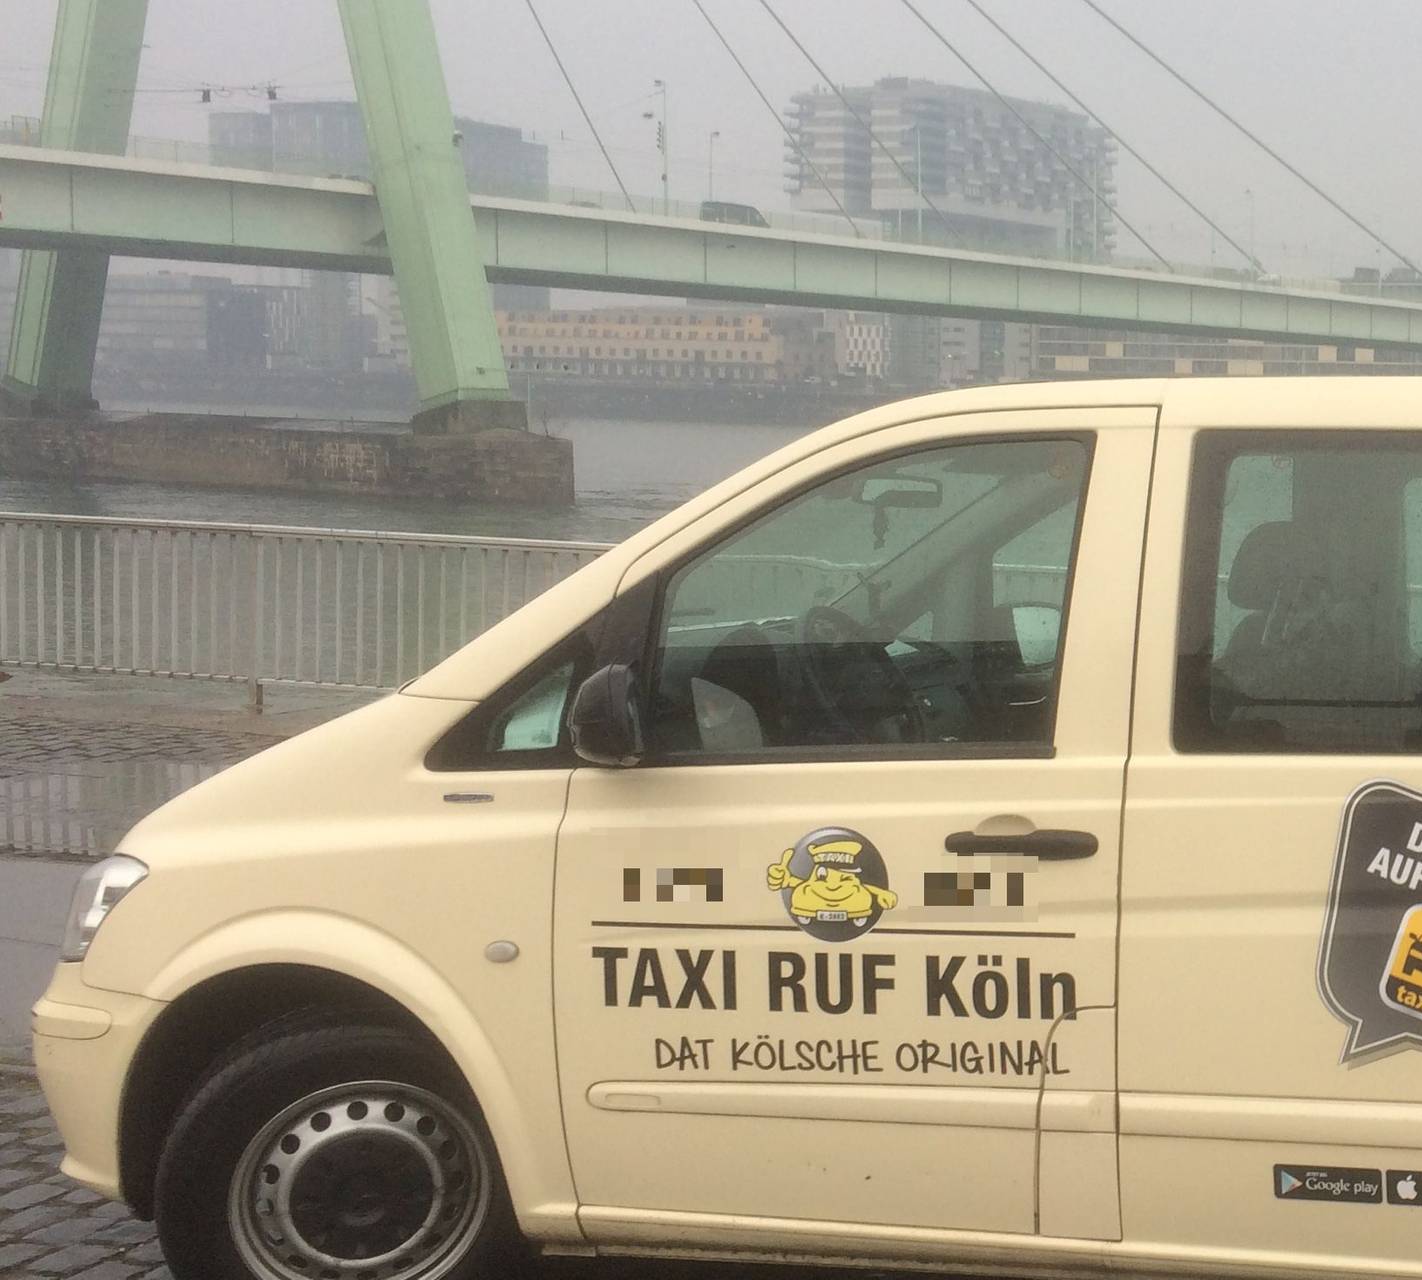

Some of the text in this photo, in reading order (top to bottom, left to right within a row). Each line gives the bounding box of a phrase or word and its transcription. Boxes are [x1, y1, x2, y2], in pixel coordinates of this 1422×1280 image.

[592, 946, 1078, 1021] TAXI RUF Köln
[654, 1034, 1071, 1076] DAT KÖLSCHE ORIGINAL
[1305, 1177, 1379, 1197] Google play
